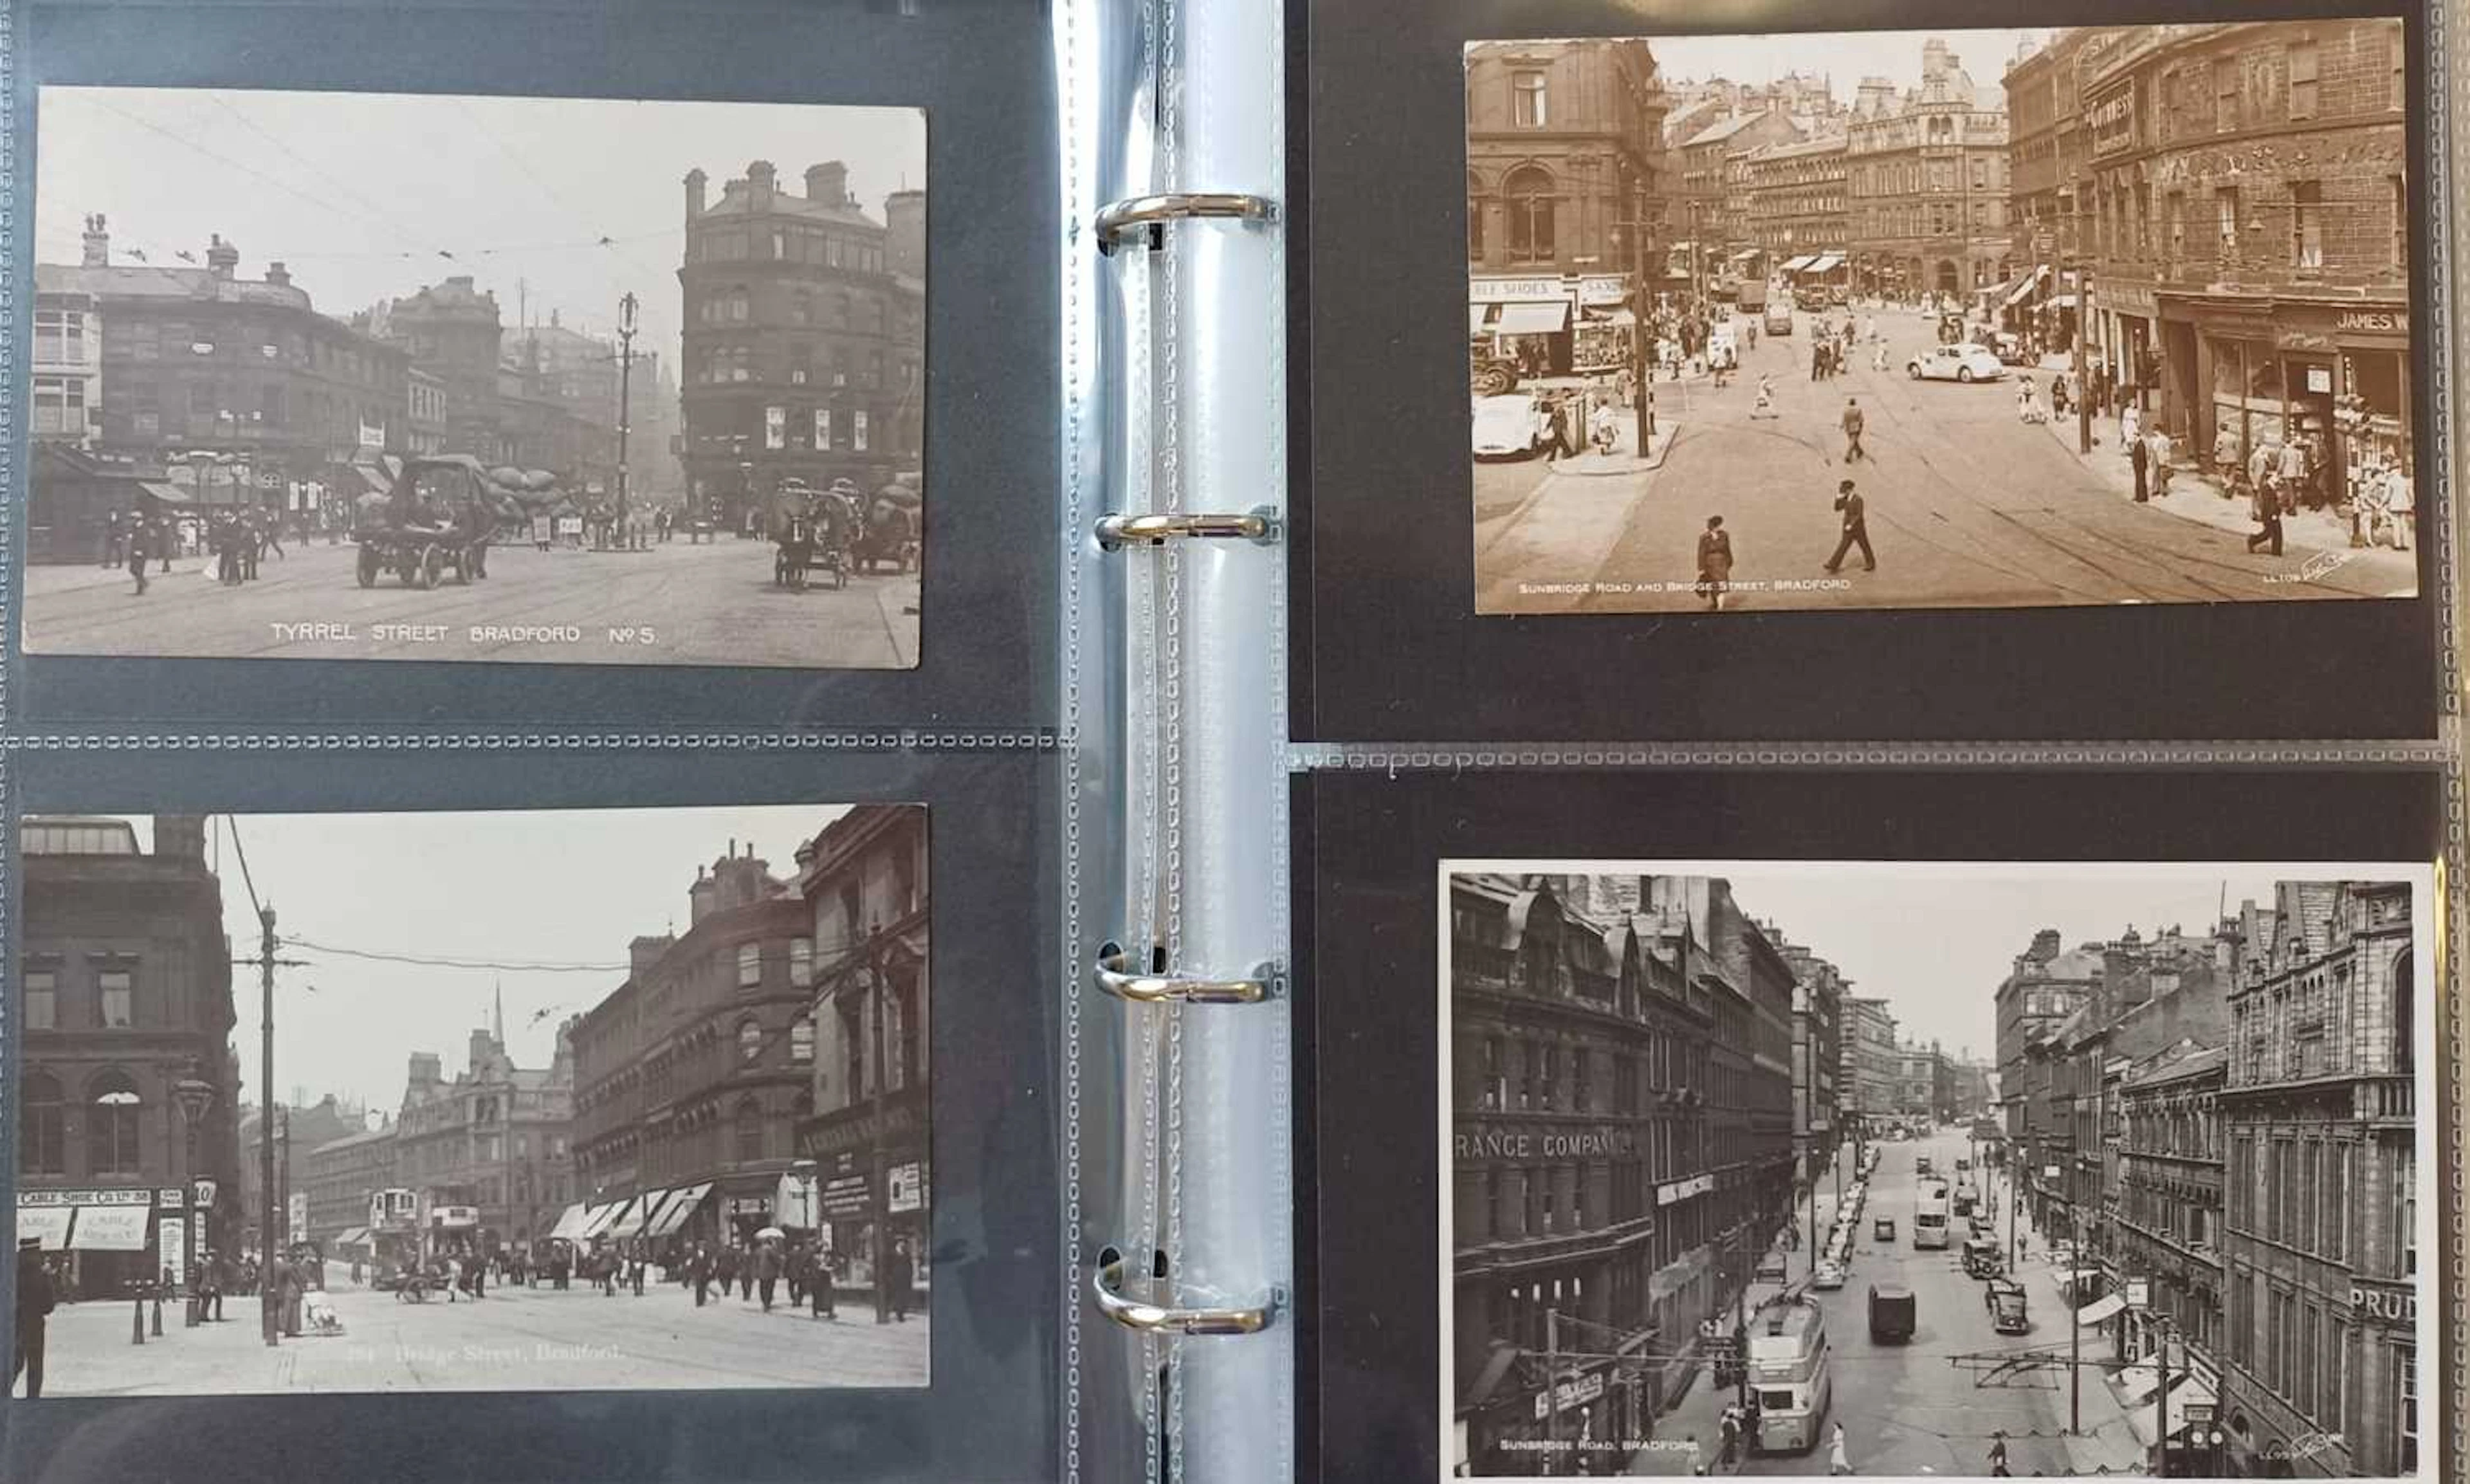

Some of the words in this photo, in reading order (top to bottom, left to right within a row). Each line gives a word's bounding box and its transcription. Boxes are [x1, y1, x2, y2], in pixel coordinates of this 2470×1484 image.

[2336, 313, 2392, 330] JAMES
[1518, 582, 1590, 594] SUNBRIDGE
[1595, 582, 1632, 593] ROAD
[1636, 582, 1662, 592] AND
[1667, 580, 1713, 592] BRIDGE
[1774, 578, 1852, 592] BRADFORD
[271, 622, 356, 641] TYRREL
[370, 625, 449, 641] STREET
[470, 626, 580, 642] BRADFORD
[1455, 1134, 1529, 1157] RANCE
[1499, 1440, 1572, 1451] SUNBRIDGE
[1622, 1440, 1699, 1451] BRADFORD
